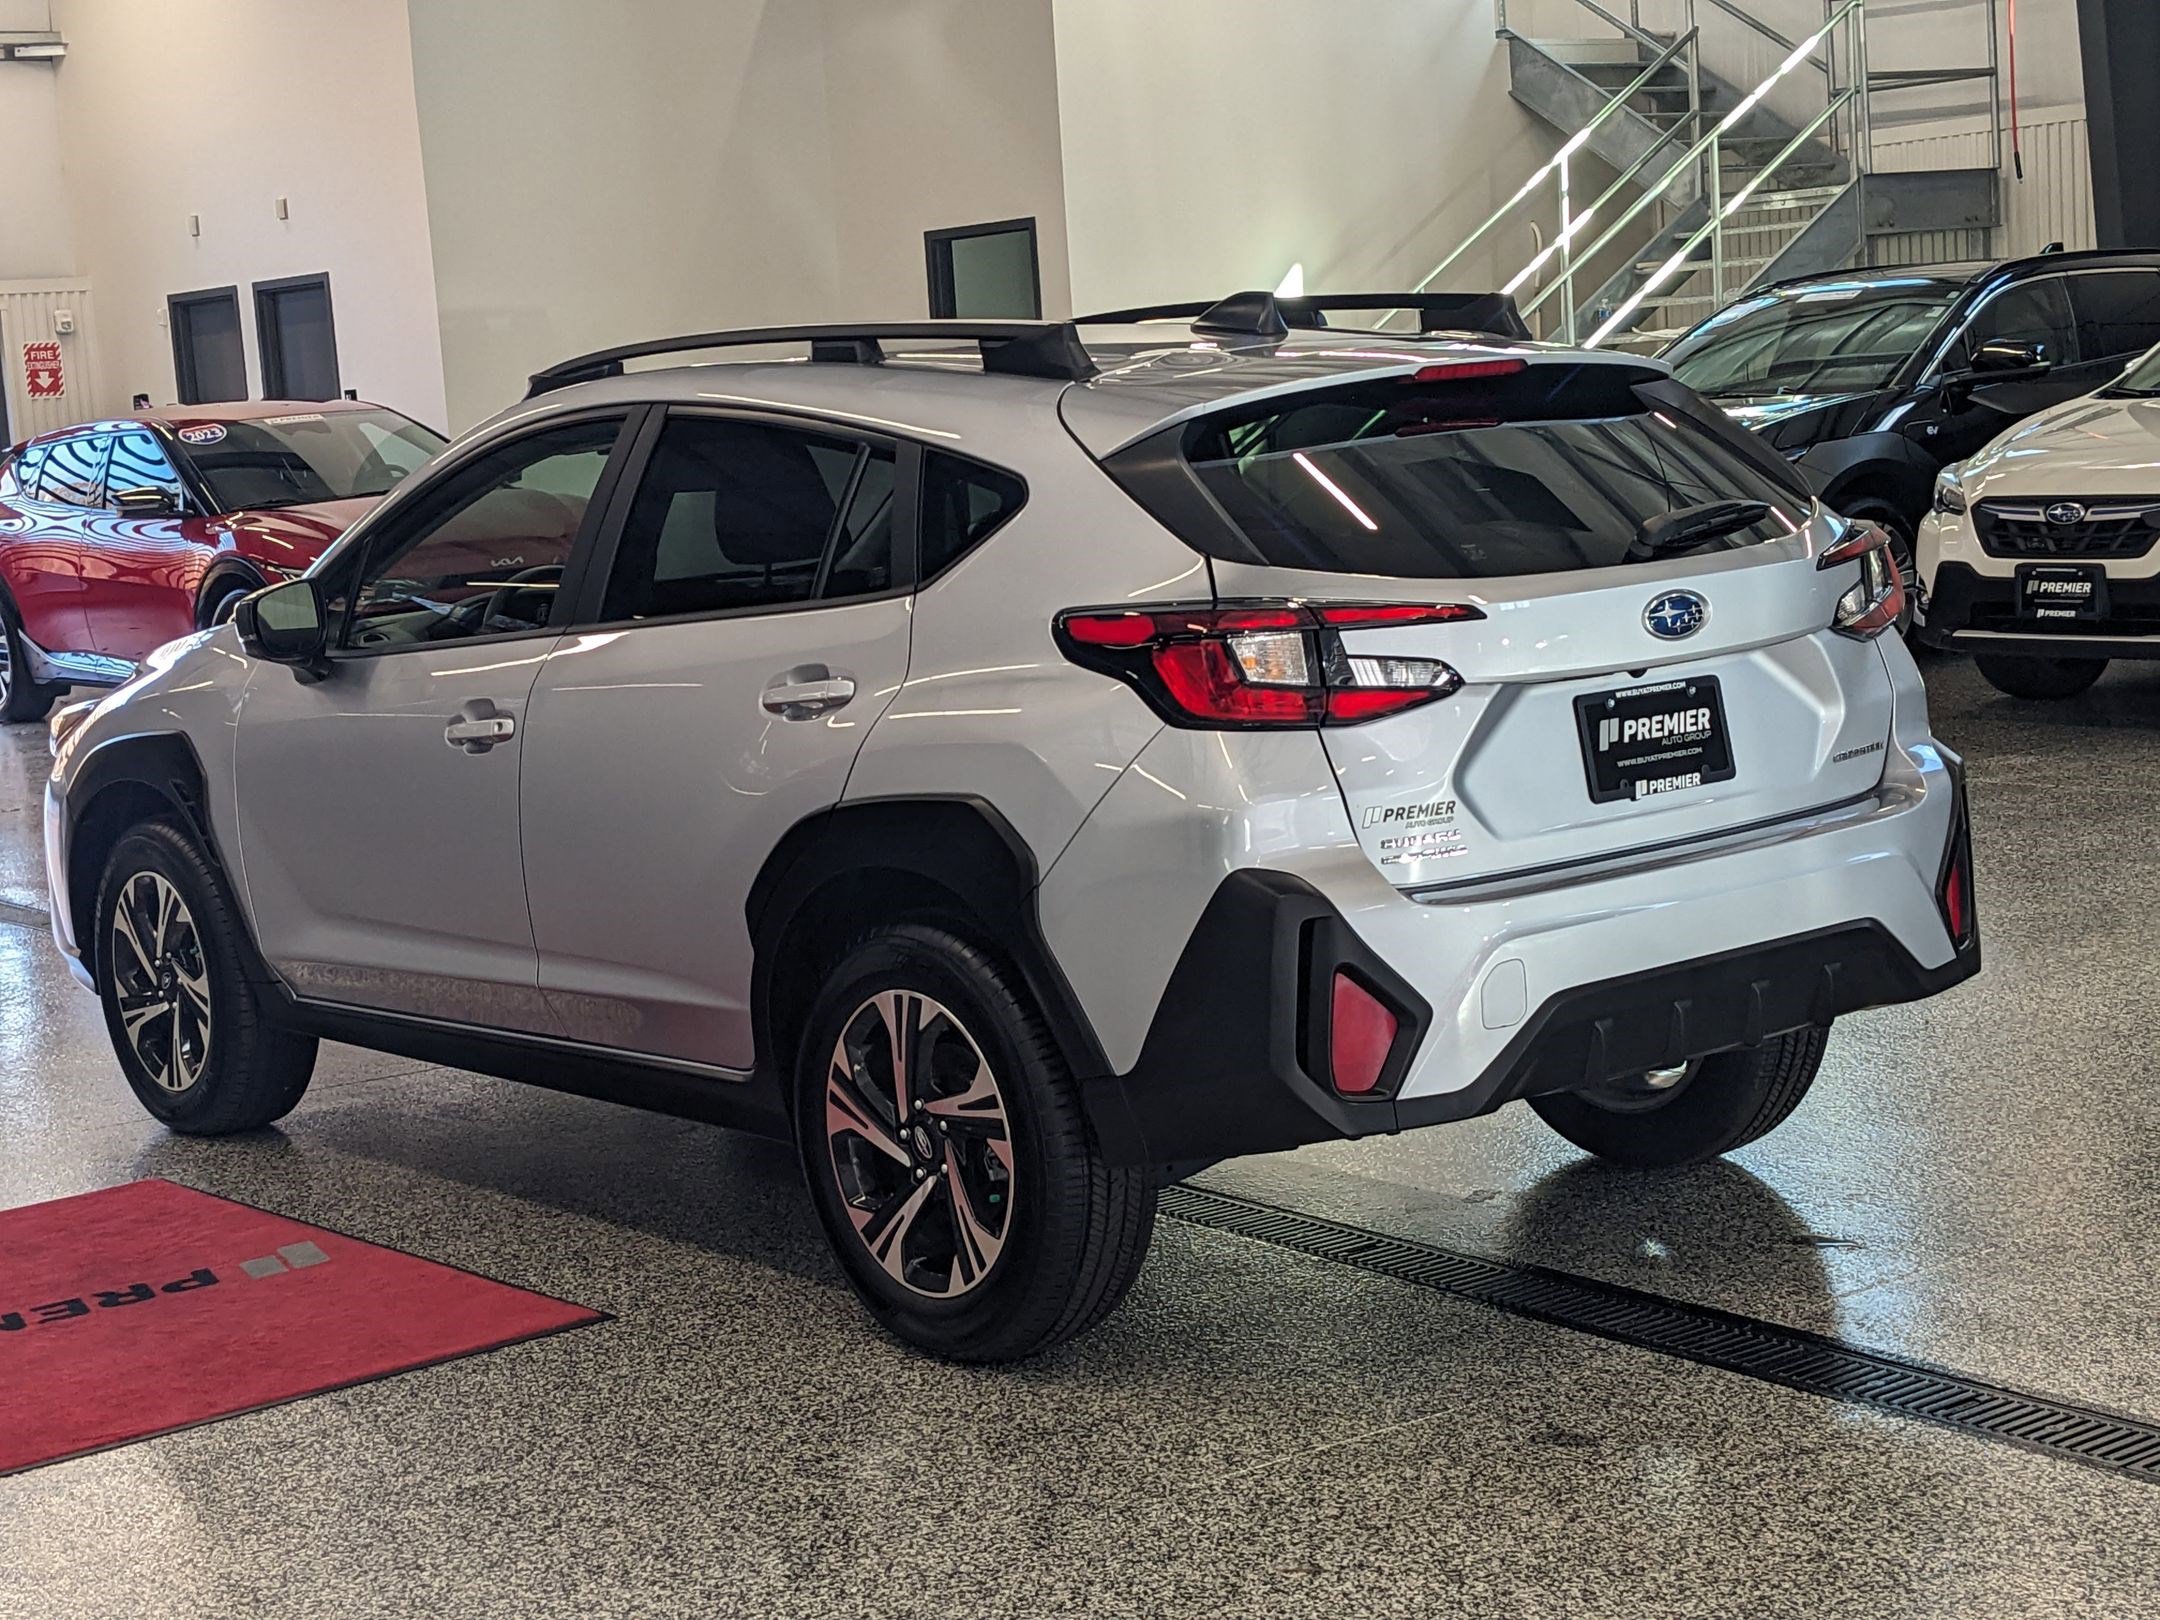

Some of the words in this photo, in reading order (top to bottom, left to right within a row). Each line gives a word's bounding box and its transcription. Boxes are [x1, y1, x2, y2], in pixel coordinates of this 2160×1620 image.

[30, 350, 55, 360] FIRE
[186, 426, 223, 442] 2023
[2039, 581, 2092, 593] PREMIER
[1615, 681, 1687, 699] WWW.BUYATPREMIER.COM
[1623, 707, 1711, 743] PREMIER
[1661, 735, 1684, 746] AUTO
[1684, 730, 1712, 742] GROUP
[1616, 747, 1703, 768] WWW.BUYATPREMIER.COM
[1649, 772, 1701, 794] PREMIER
[1383, 800, 1457, 822] PREMIER
[1405, 820, 1426, 829] AUTO
[1427, 816, 1454, 826] GROUP
